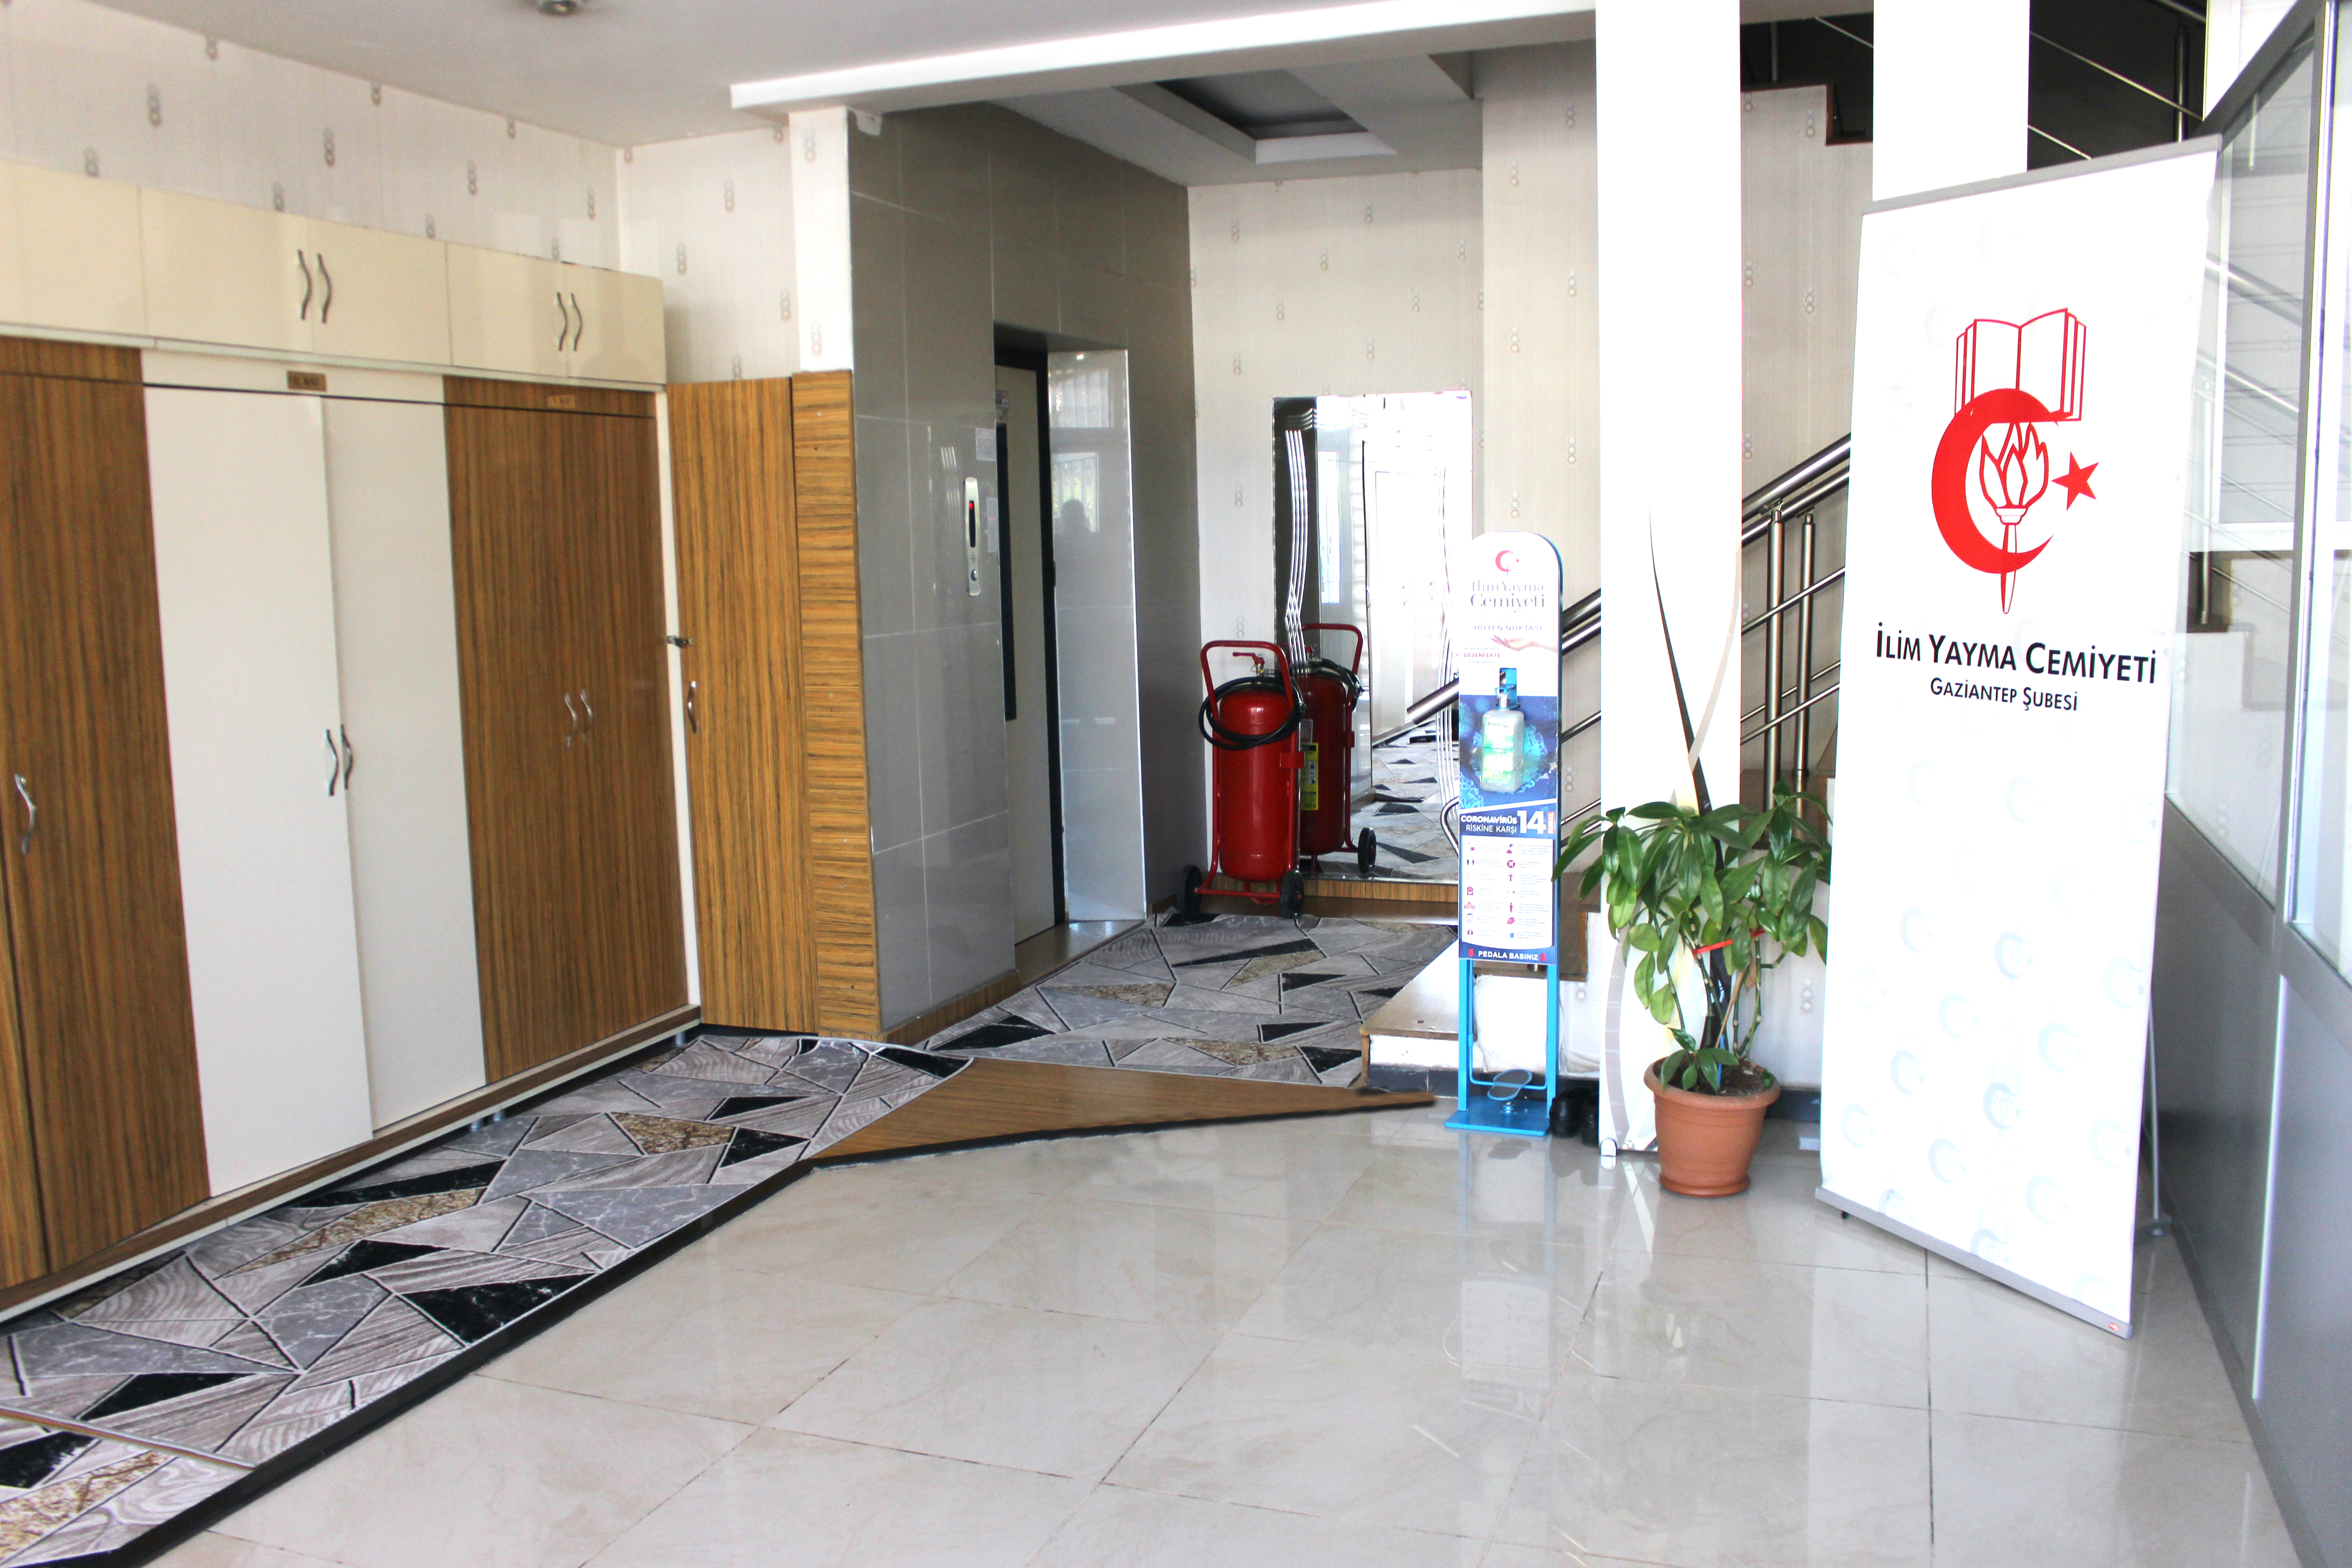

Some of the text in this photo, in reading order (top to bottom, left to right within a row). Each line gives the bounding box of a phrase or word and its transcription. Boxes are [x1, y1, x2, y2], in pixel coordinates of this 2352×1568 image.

[1502, 581, 1544, 593] Yayma
[1470, 593, 1544, 612] Cemiyeti
[1928, 633, 2017, 671] YAYMA
[2025, 642, 2156, 684] CEMİYETİ
[1930, 677, 2078, 711] GAZİANTEP ŞUBESİ
[1460, 815, 1518, 824] CORONAVİRÜS
[1517, 810, 1547, 834] 14
[1466, 823, 1517, 834] RİSKİNE KARŞI
[1478, 951, 1507, 959] PEDALA
